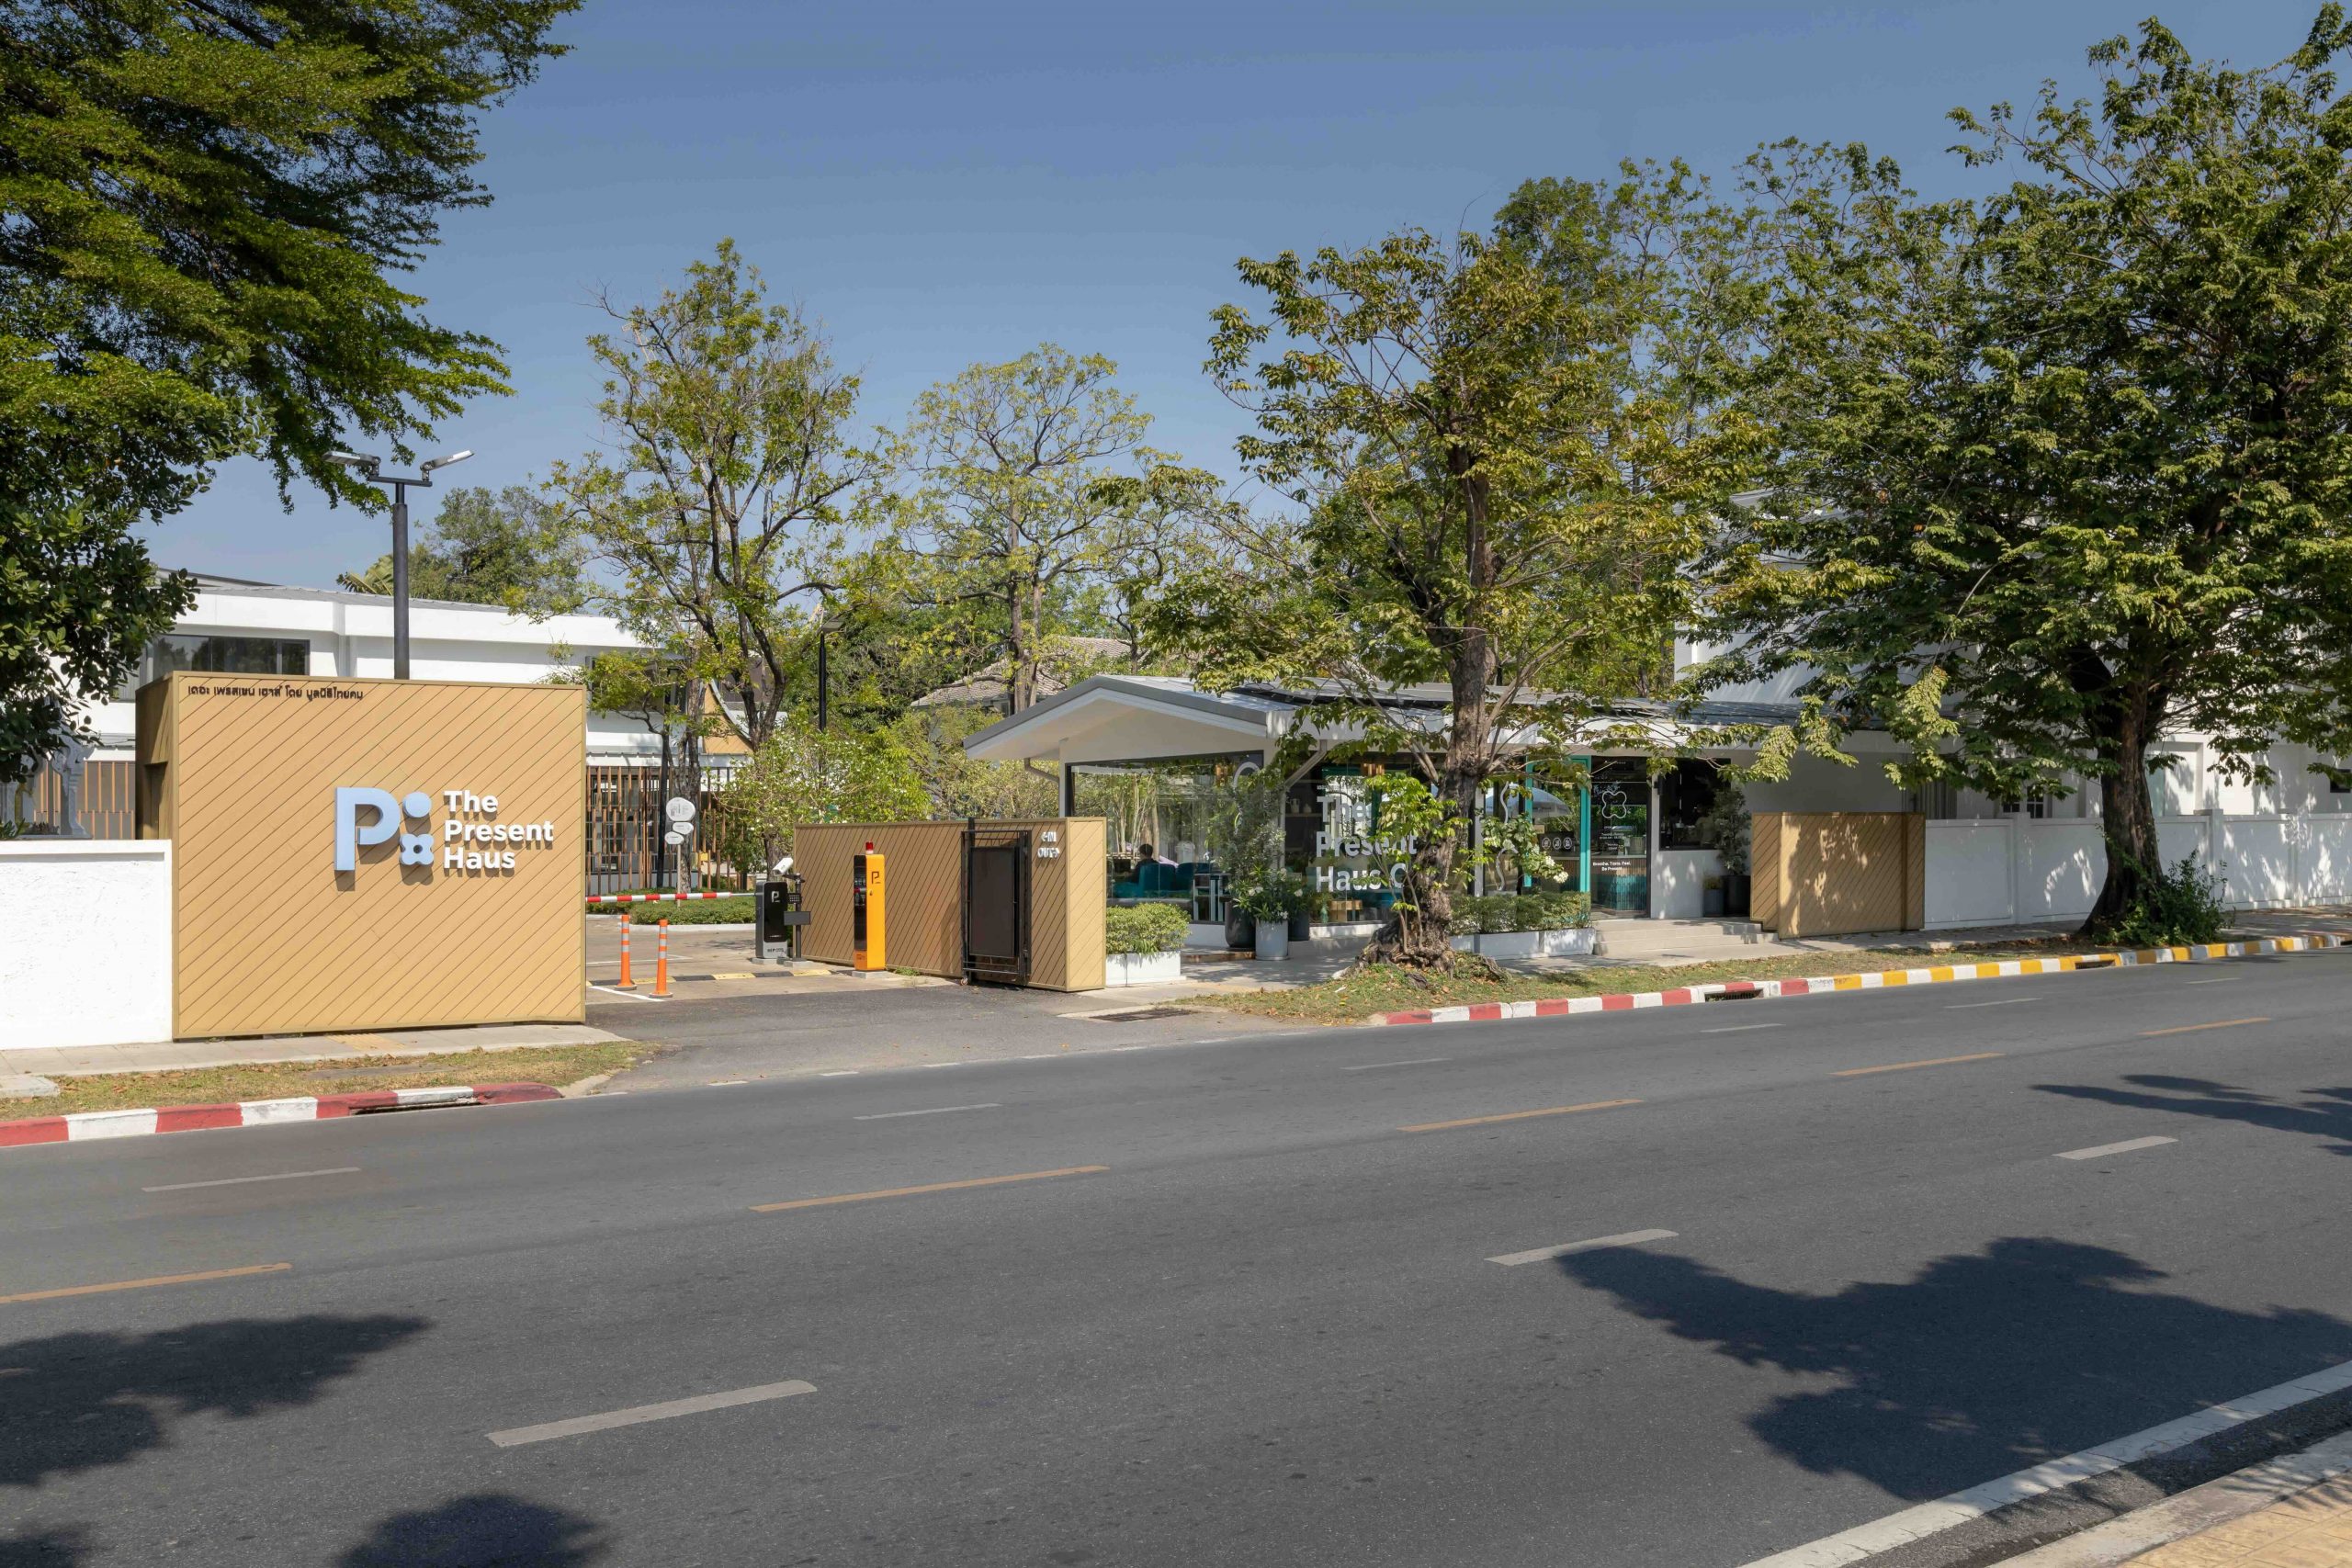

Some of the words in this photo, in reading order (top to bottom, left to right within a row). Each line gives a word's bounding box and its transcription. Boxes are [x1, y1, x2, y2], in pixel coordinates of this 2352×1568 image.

[285, 684, 302, 698] โดย
[444, 790, 499, 813] The
[1317, 795, 1369, 822] The
[445, 819, 554, 841] Present
[444, 846, 516, 869] Haus
[1316, 865, 1381, 893] Haus
